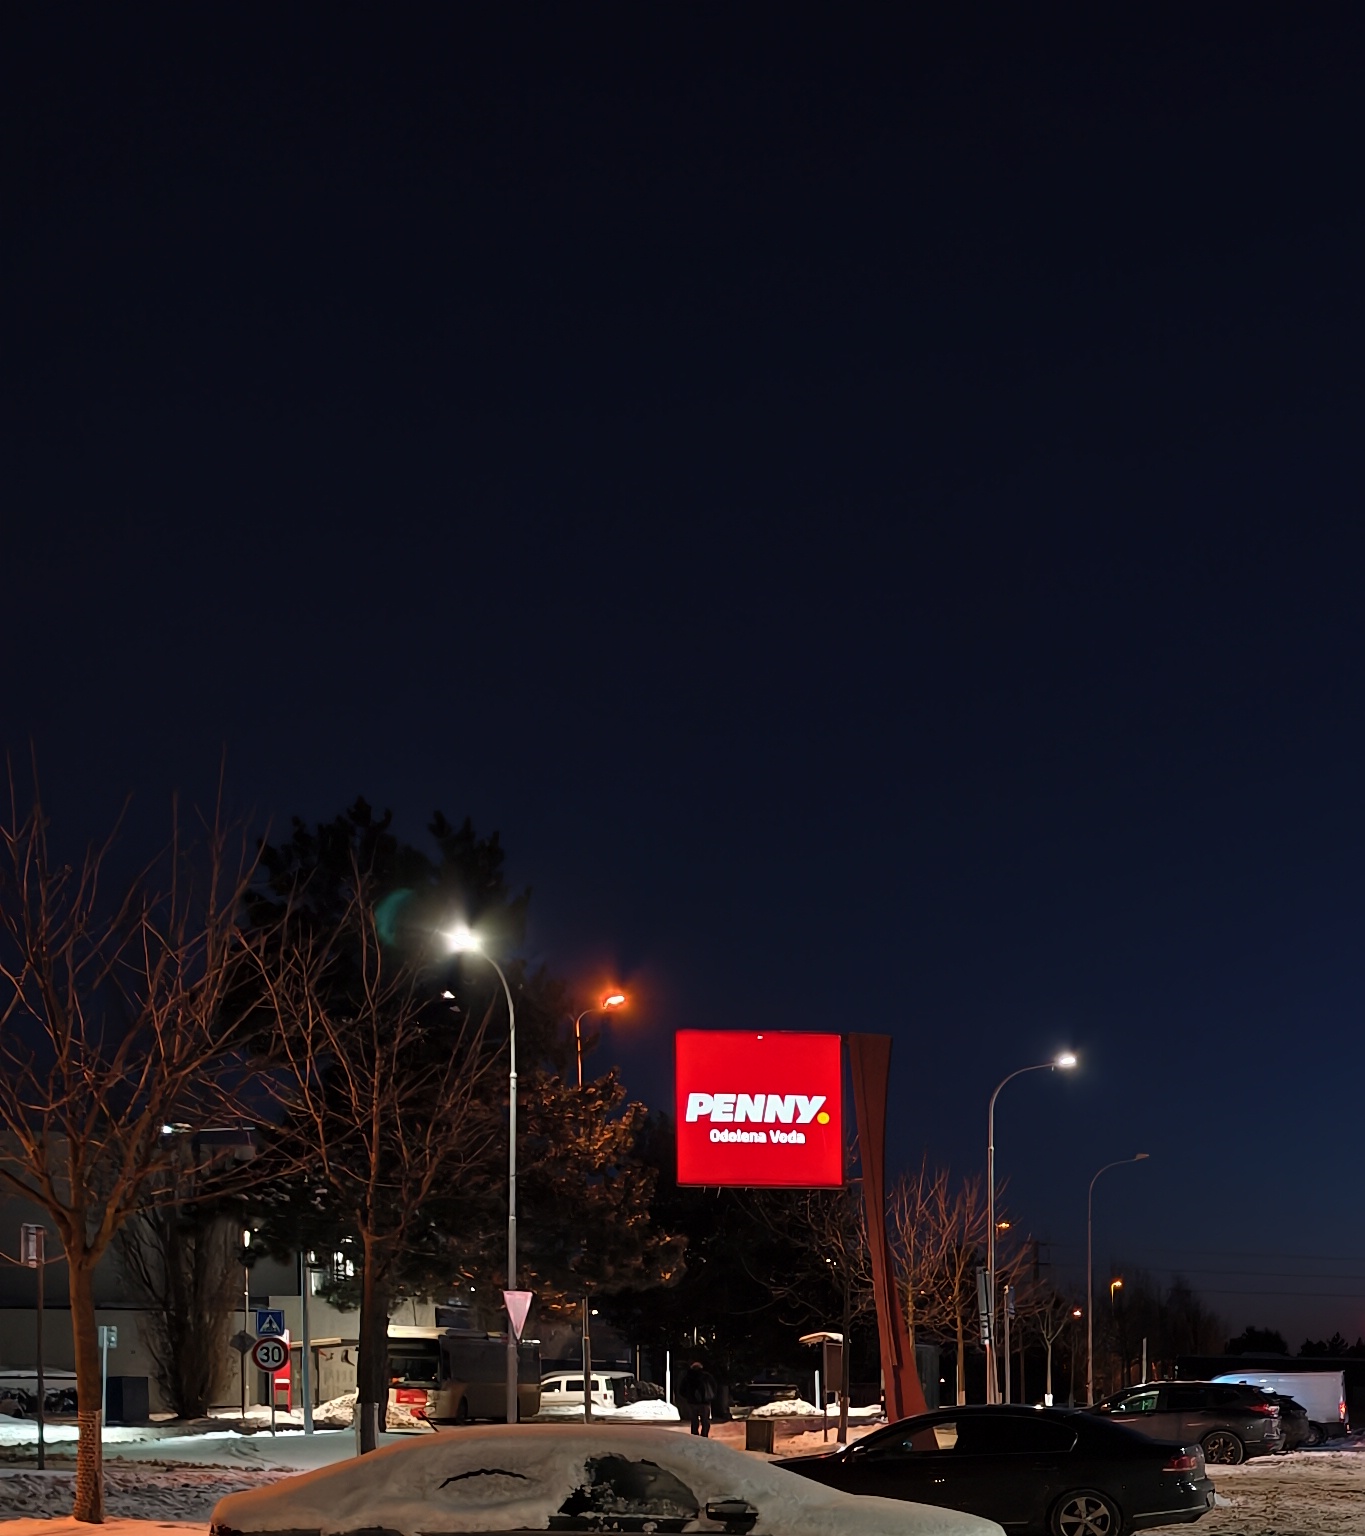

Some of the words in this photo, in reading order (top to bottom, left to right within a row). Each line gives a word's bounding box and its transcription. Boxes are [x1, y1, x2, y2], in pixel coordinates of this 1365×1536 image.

[709, 1128, 767, 1143] Odolena
[769, 1129, 806, 1144] Voda
[259, 1346, 282, 1363] 30
